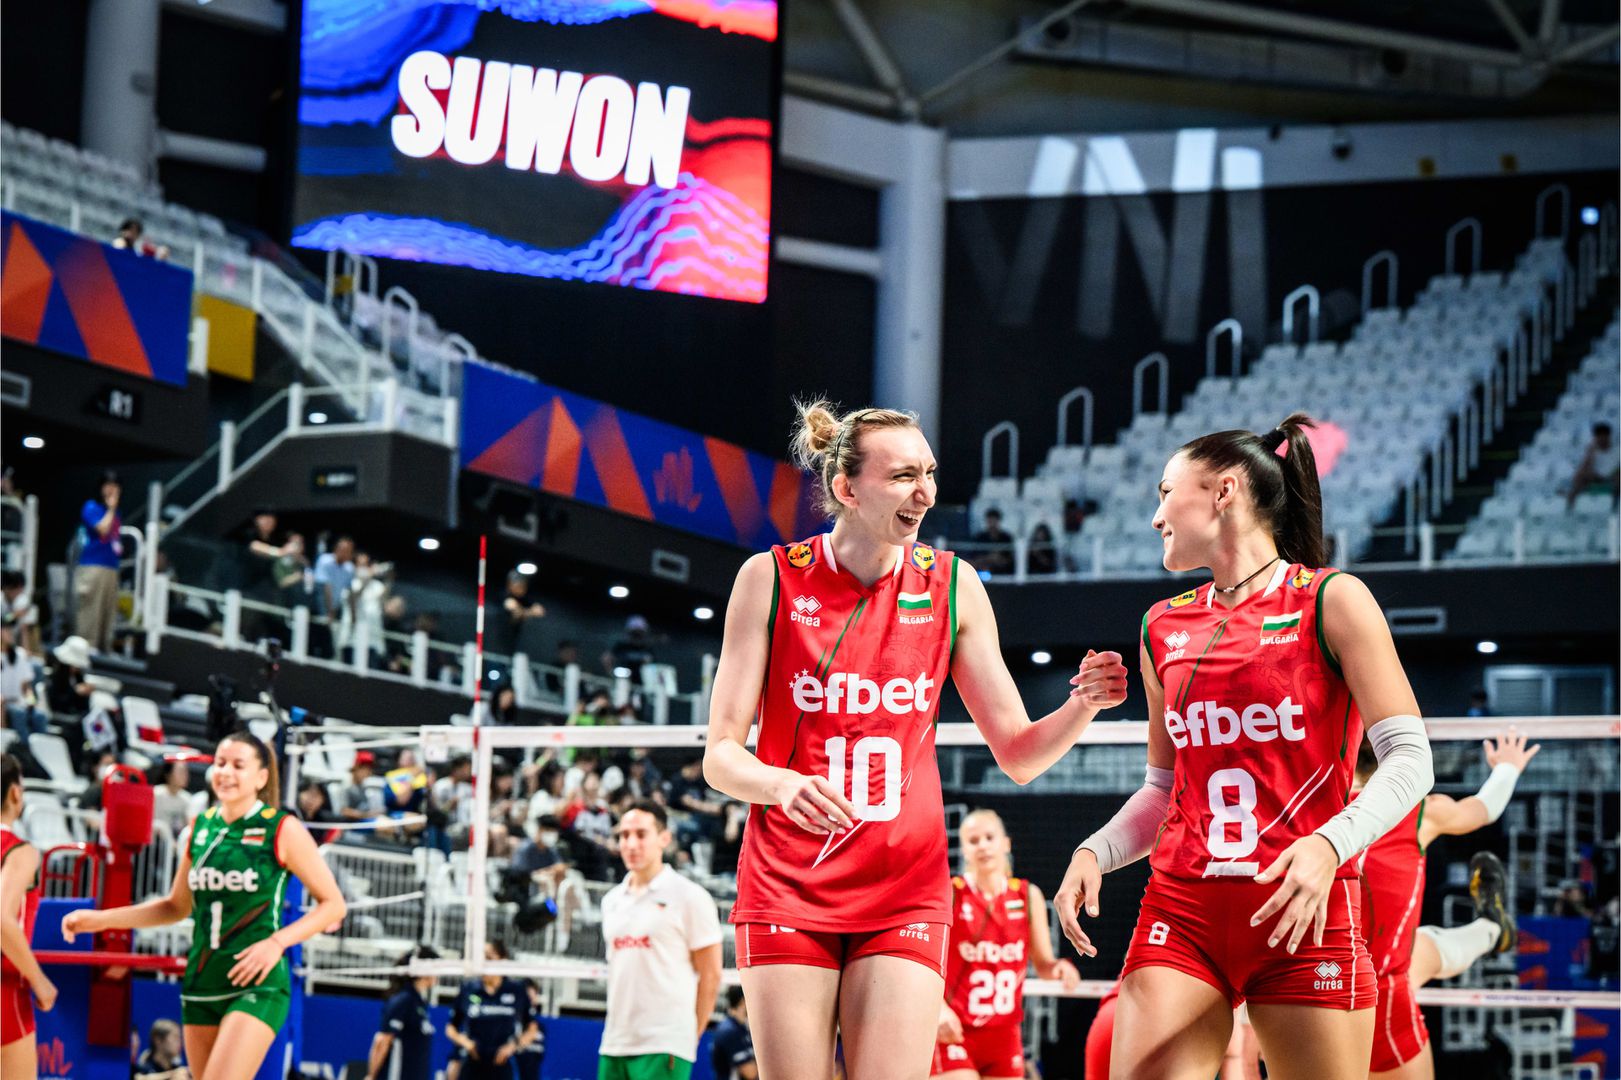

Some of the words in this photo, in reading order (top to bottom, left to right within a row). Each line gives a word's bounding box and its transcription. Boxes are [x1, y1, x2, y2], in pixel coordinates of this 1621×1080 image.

[391, 50, 691, 190] SUWON
[790, 611, 820, 627] errea
[899, 614, 935, 625] BULGARIA
[1260, 633, 1299, 646] BULGARIA
[792, 671, 934, 715] efbet
[1164, 696, 1306, 750] efbet
[825, 736, 903, 822] 10
[1207, 767, 1259, 859] 8
[187, 867, 259, 893] efbet
[210, 901, 223, 950] 1
[900, 929, 930, 942] errea
[1148, 921, 1171, 946] 8
[957, 940, 1025, 964] efbet
[968, 969, 1018, 1016] 28
[1313, 979, 1343, 990] errea
